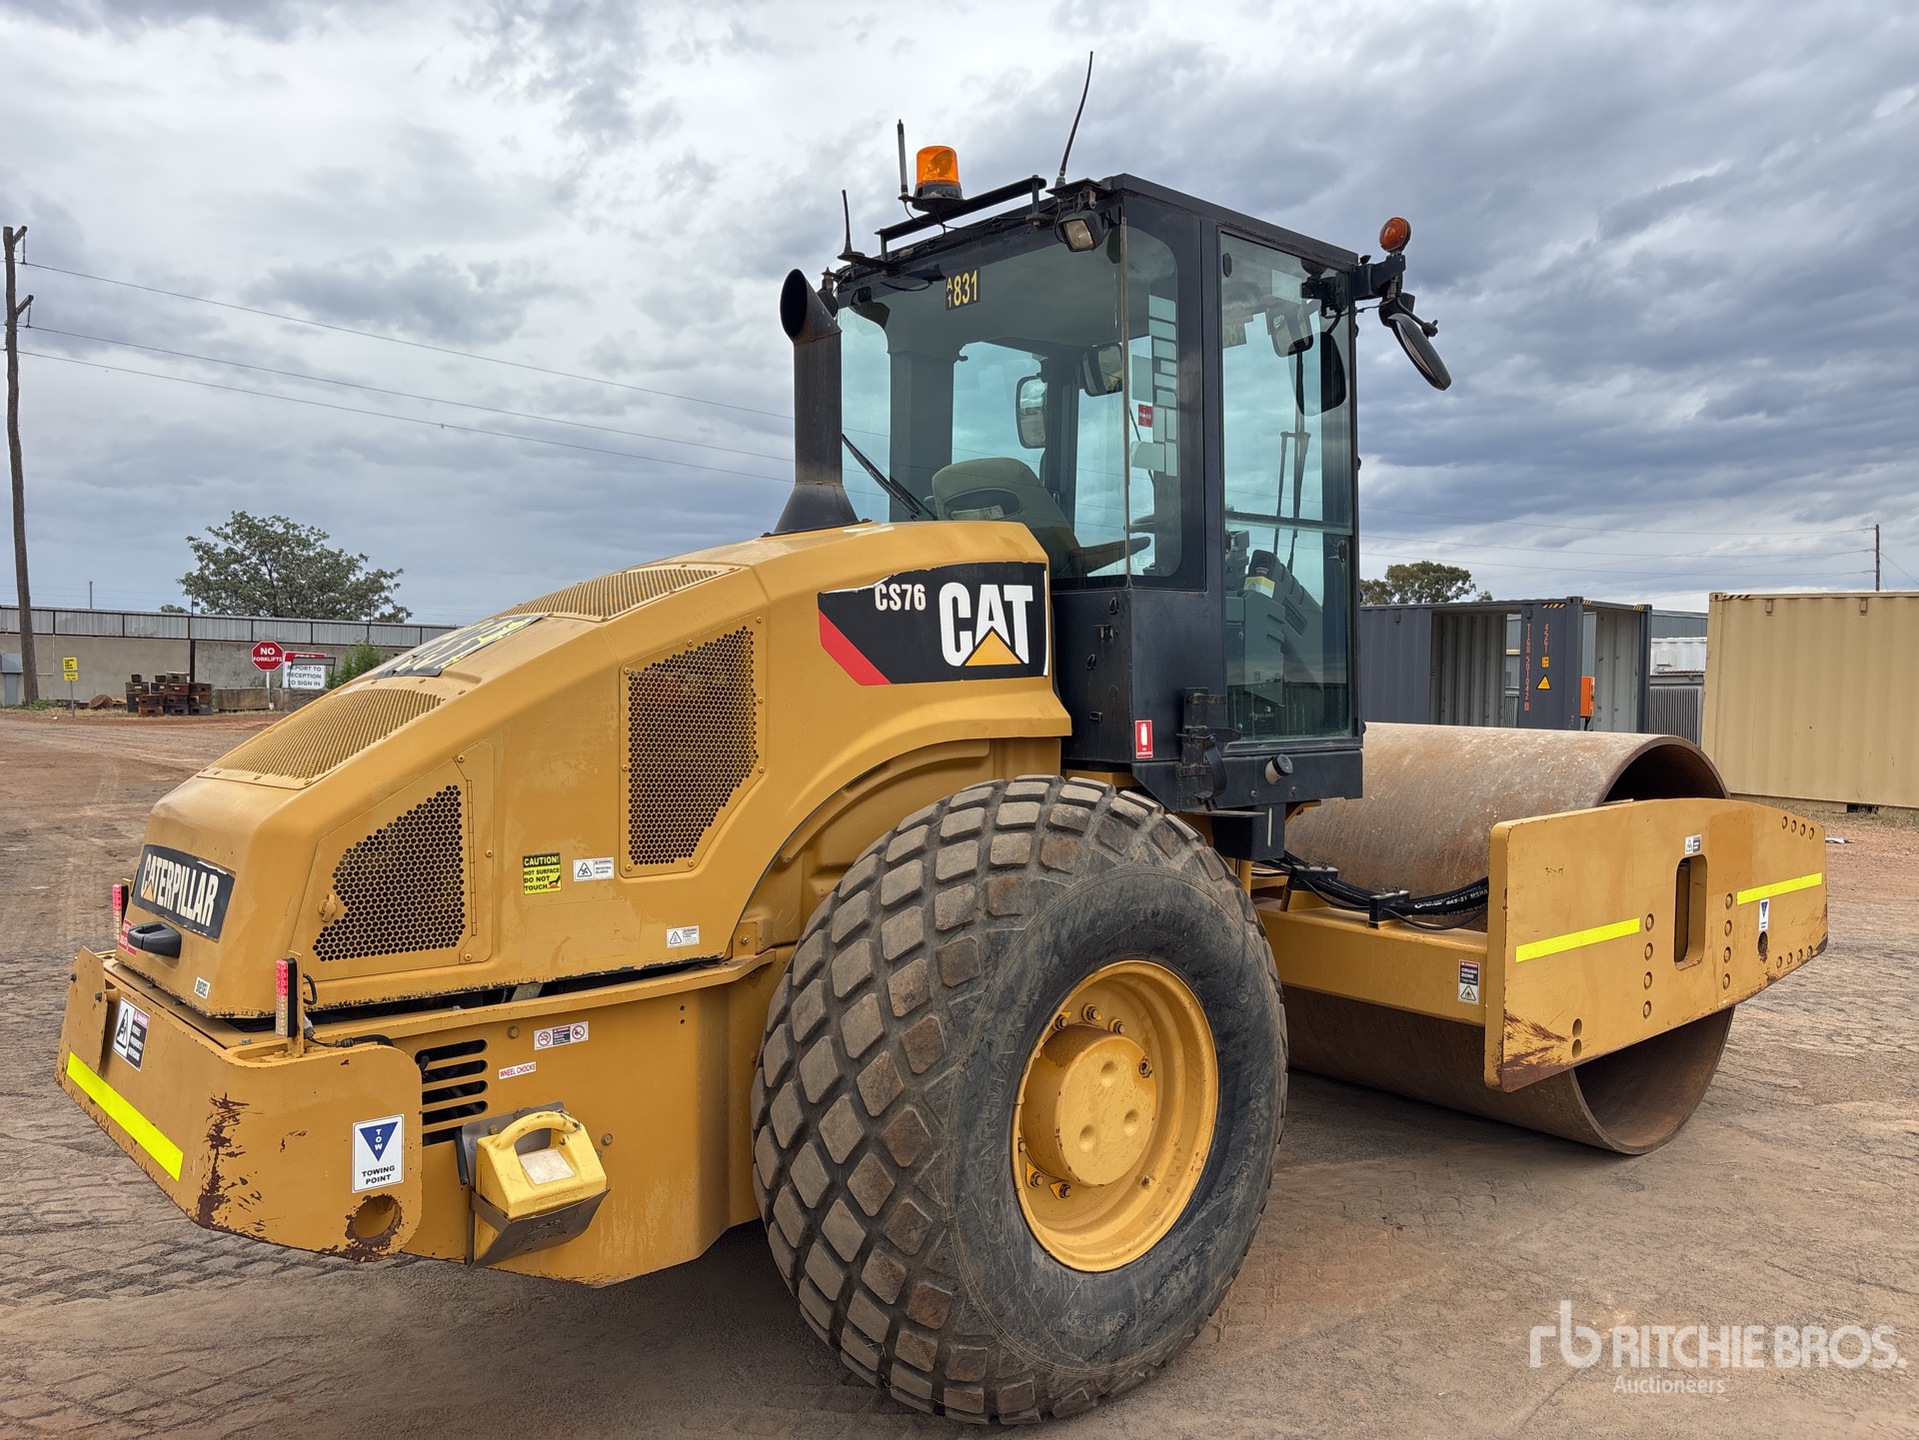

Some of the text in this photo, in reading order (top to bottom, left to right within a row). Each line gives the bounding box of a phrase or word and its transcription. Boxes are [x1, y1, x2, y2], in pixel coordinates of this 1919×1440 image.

[954, 270, 977, 306] 831
[874, 583, 926, 611] CS76
[939, 581, 1033, 666] CAT
[260, 647, 275, 655] NO
[535, 875, 551, 883] NOT
[140, 853, 219, 927] CATERPILLAR
[500, 1063, 536, 1078] WHEEL CHOCKS
[374, 1128, 383, 1151] TOW
[361, 1165, 395, 1177] TOWING
[365, 1174, 392, 1185] POINT
